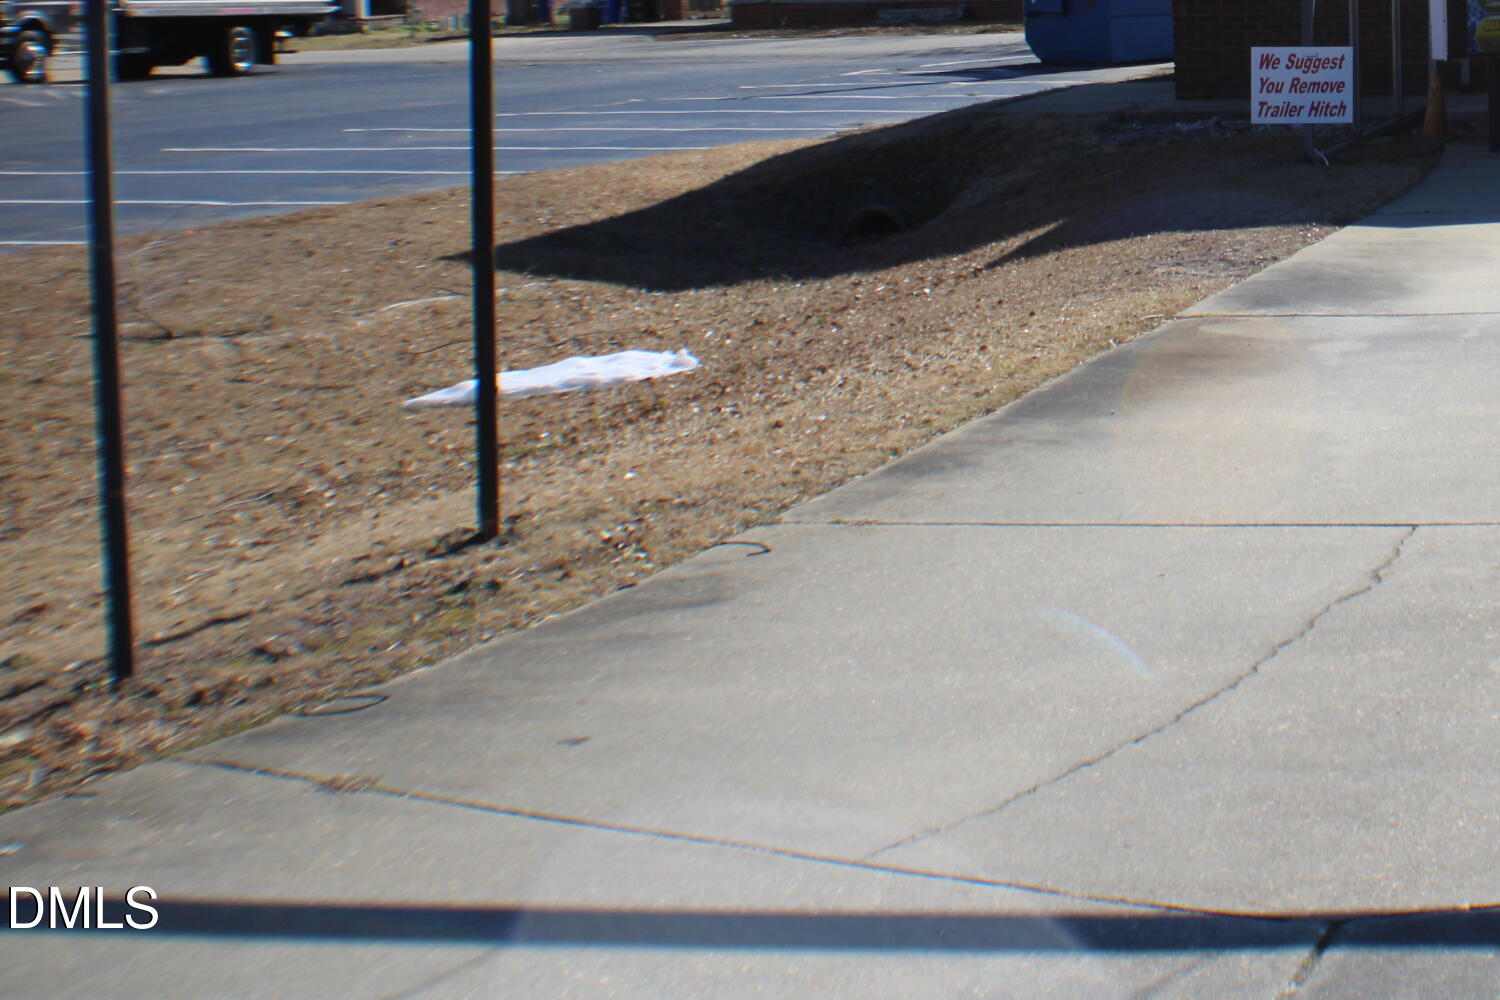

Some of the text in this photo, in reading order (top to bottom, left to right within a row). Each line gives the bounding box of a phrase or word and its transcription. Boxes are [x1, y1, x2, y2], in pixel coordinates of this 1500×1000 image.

[1258, 53, 1346, 74] We Suggest
[1258, 77, 1346, 94] You Remove
[1257, 101, 1348, 118] Trailer Hitch
